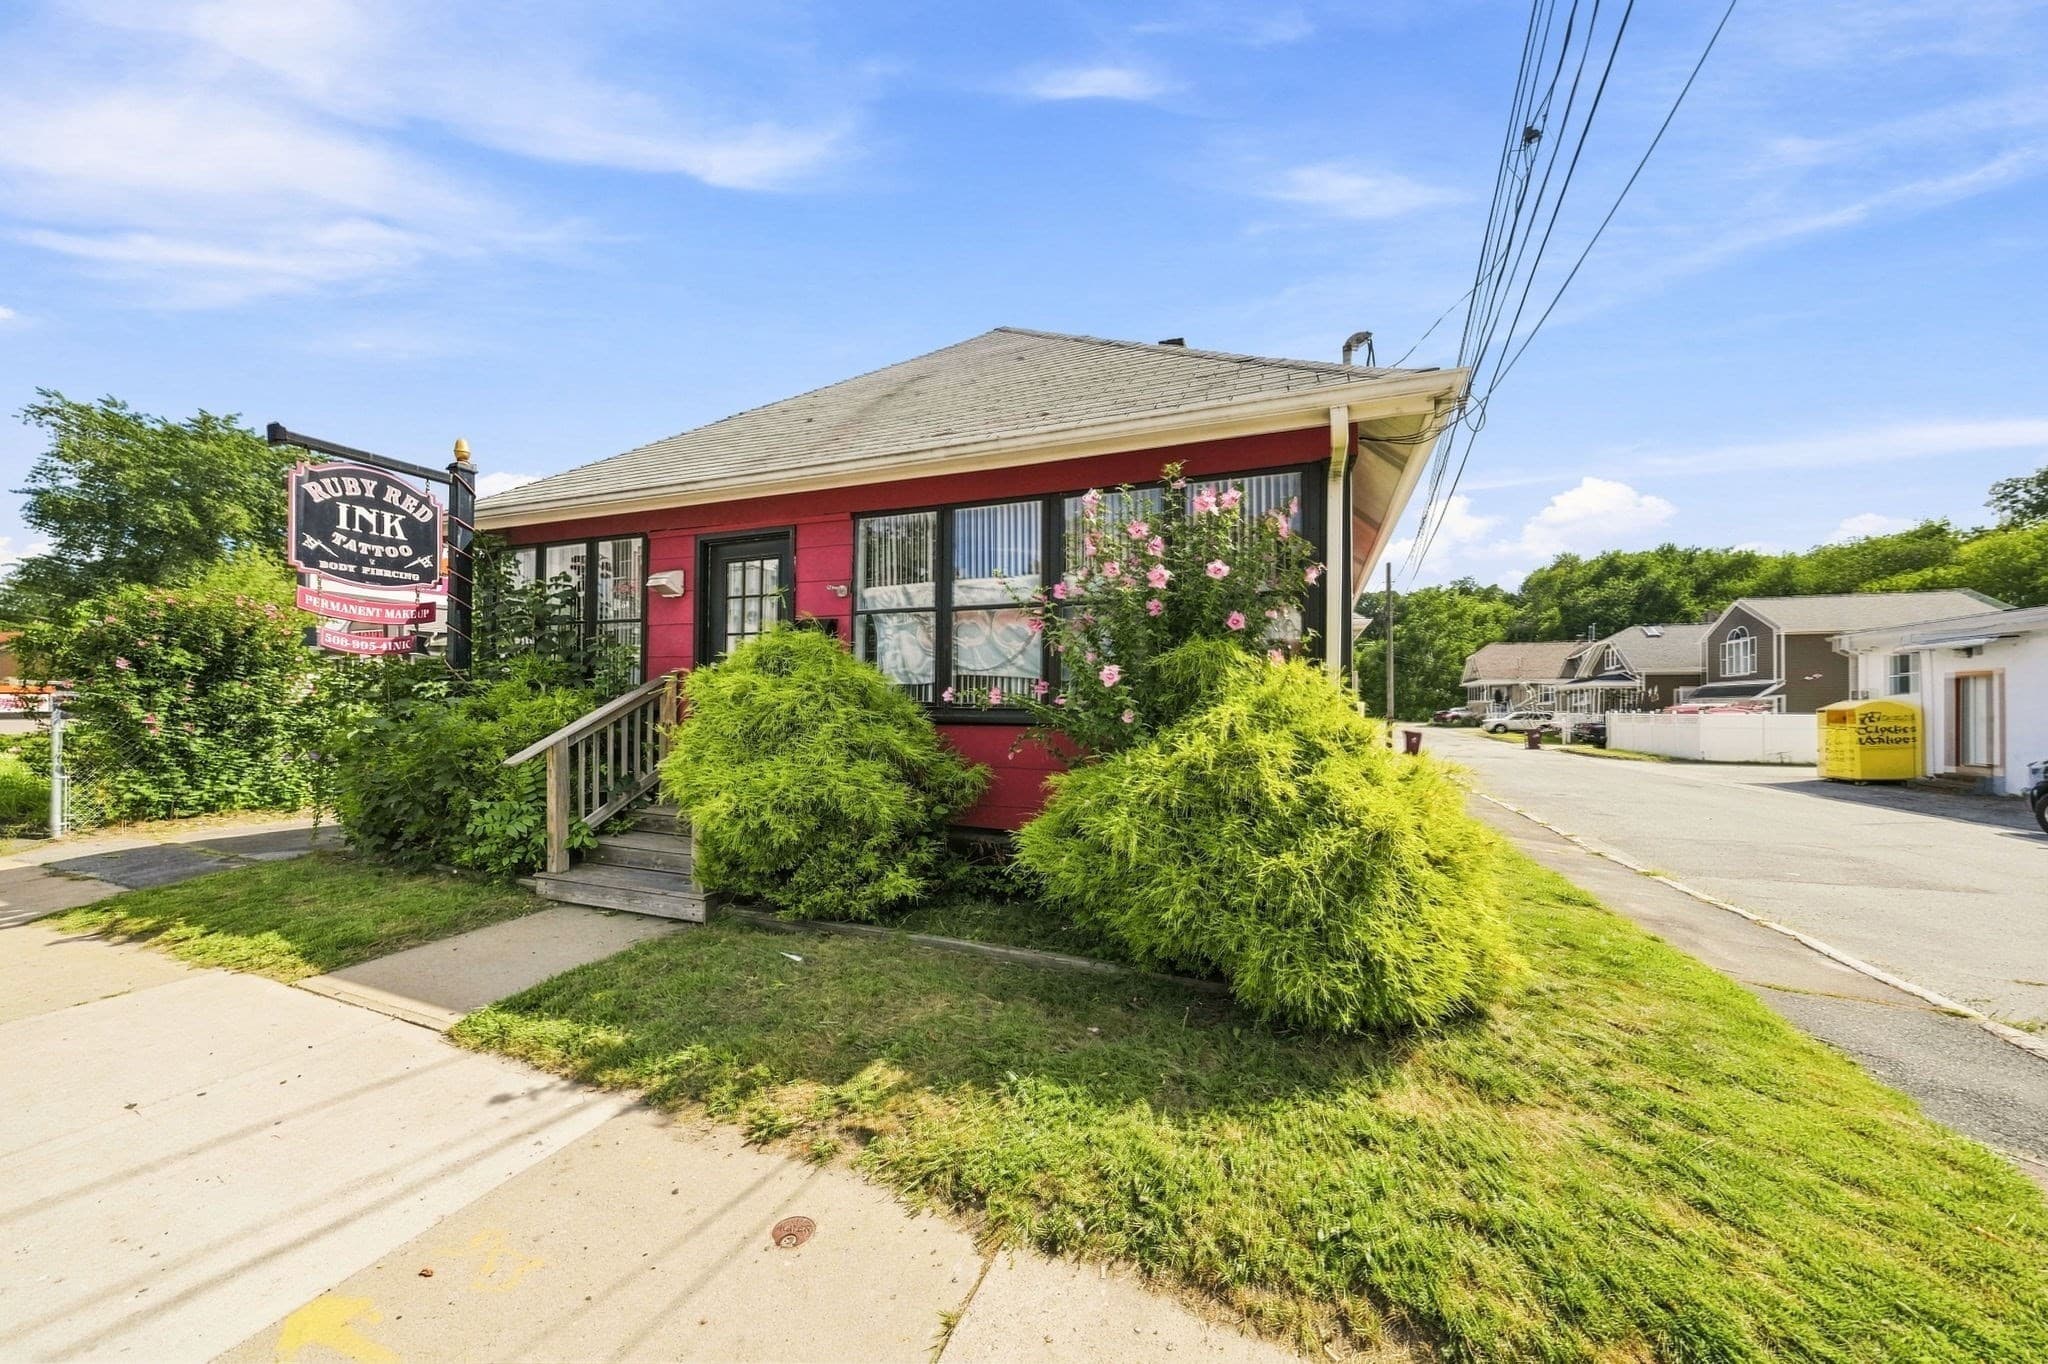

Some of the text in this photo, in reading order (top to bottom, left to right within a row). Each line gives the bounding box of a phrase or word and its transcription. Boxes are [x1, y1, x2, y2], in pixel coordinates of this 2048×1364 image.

[302, 477, 434, 523] RUBY RED
[336, 501, 408, 541] INK
[331, 531, 413, 558] TATTOO
[319, 560, 420, 581] BODY PIERCING
[304, 594, 382, 616] PERMANENT
